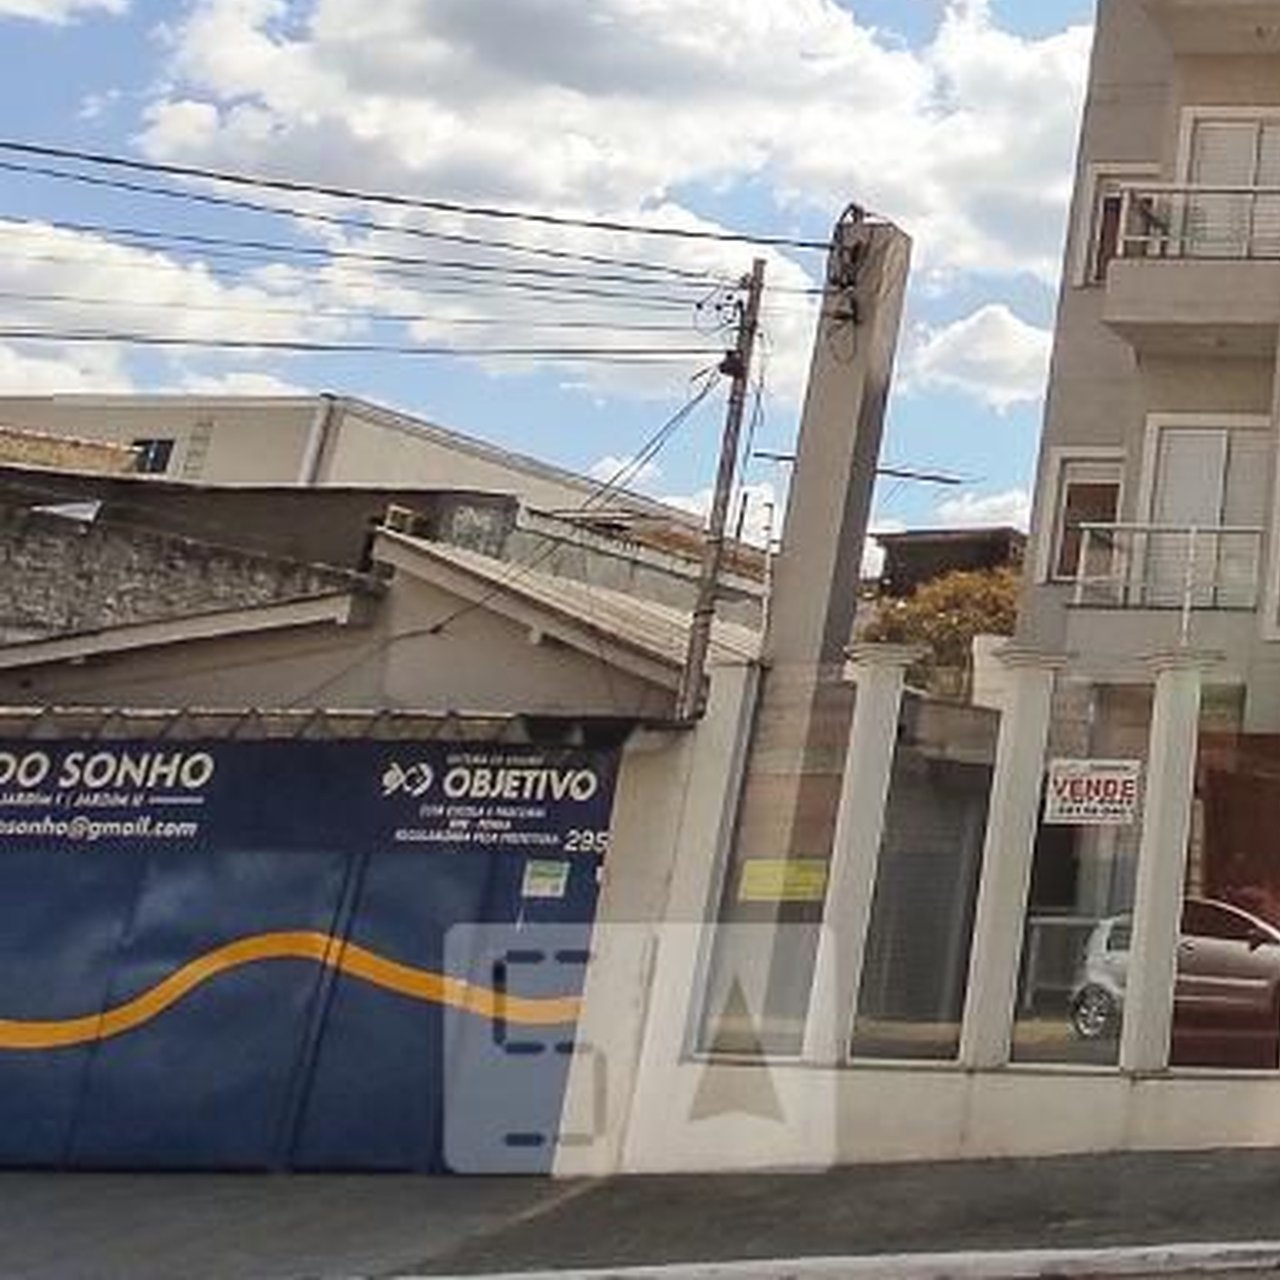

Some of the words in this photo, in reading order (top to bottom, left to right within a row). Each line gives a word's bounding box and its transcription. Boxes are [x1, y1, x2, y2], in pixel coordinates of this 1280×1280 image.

[0, 751, 50, 787] DO
[58, 751, 214, 788] SONHO
[443, 767, 598, 801] OBJETIVO
[1053, 778, 1135, 800] VENDE
[563, 828, 609, 854] 295
